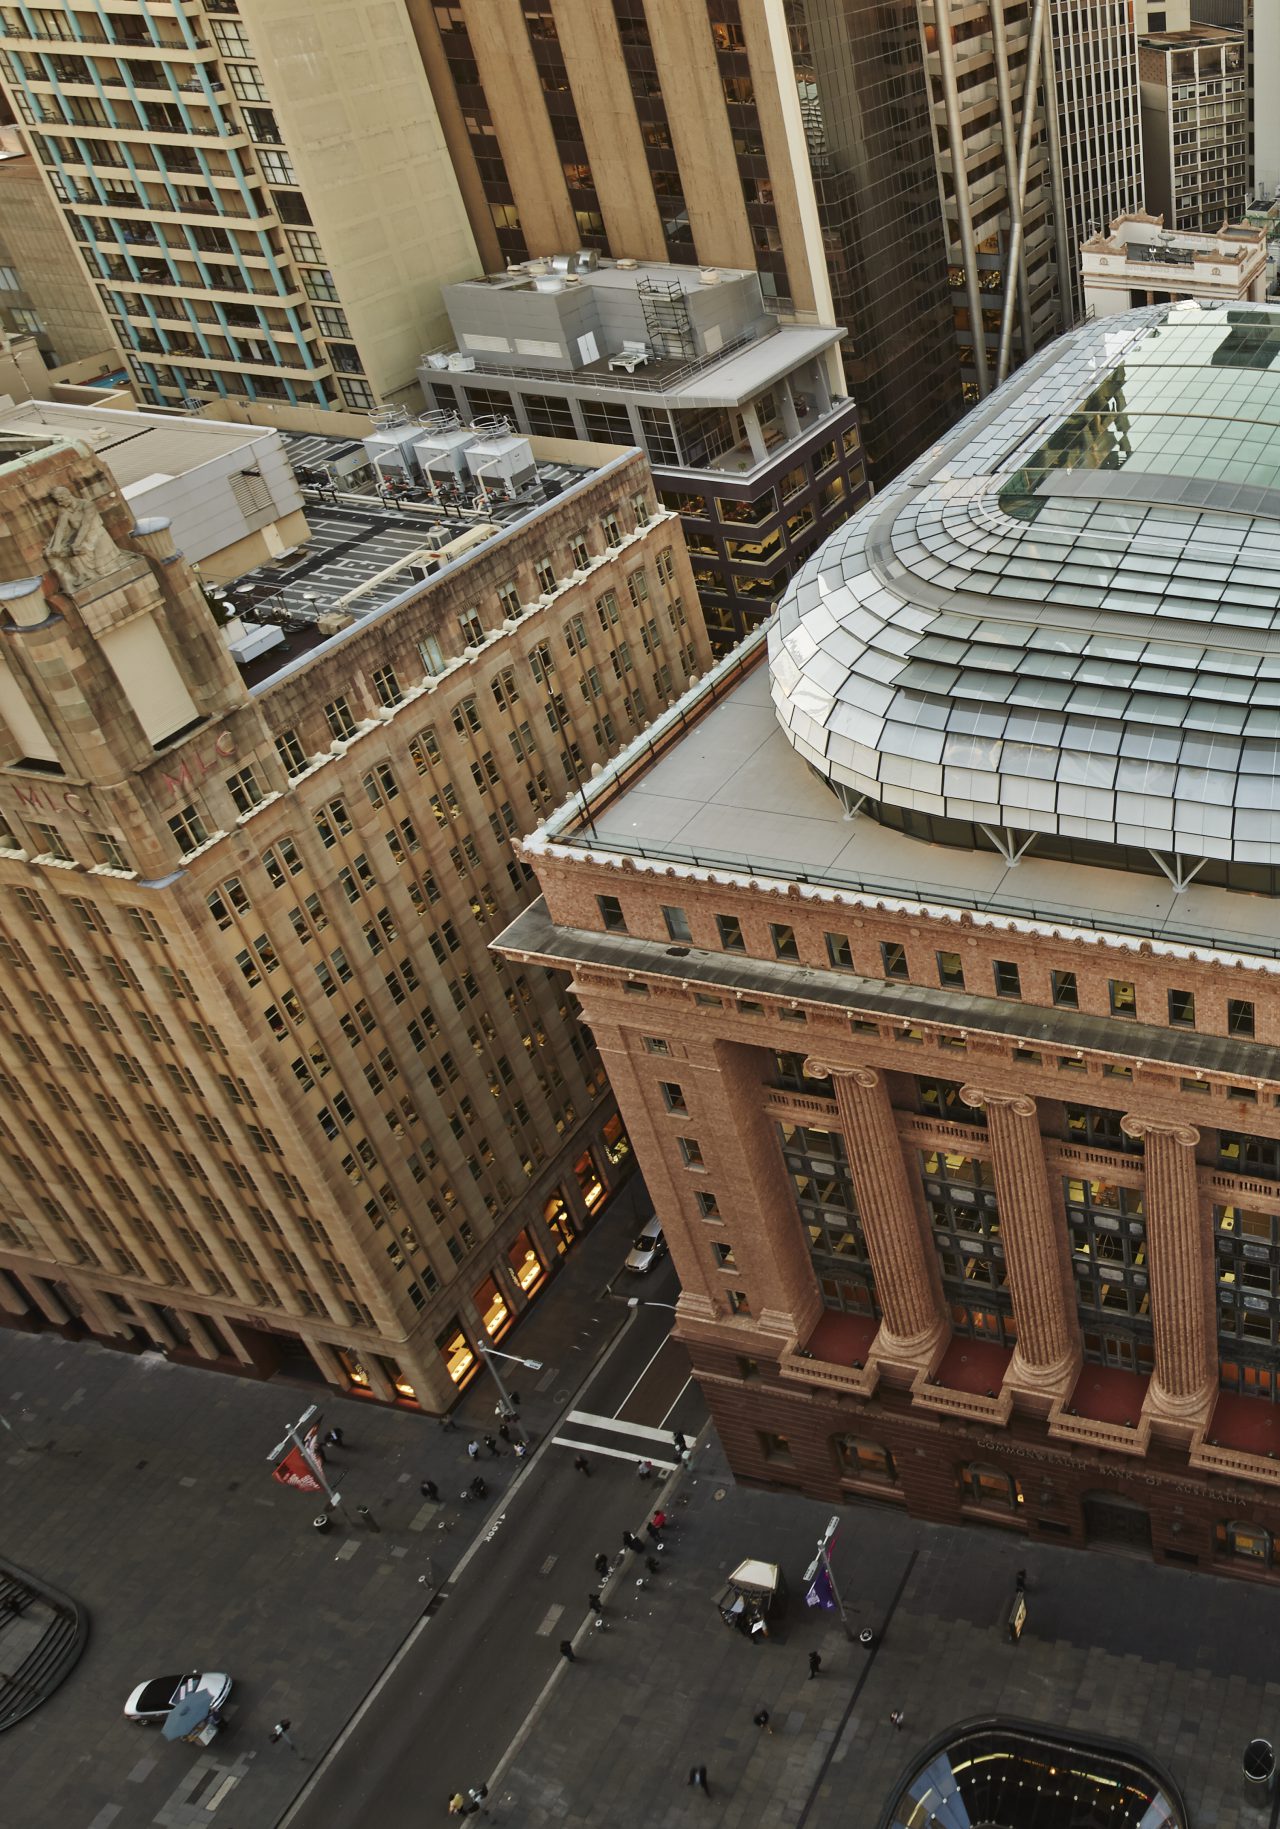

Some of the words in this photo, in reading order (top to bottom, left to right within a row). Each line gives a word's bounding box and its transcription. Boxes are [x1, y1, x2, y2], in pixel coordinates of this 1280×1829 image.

[161, 730, 237, 798] MLC
[10, 783, 91, 817] MLC
[977, 1440, 1086, 1471] COMMONWEALTH
[1099, 1465, 1135, 1481] BANK
[1145, 1477, 1162, 1487] OF
